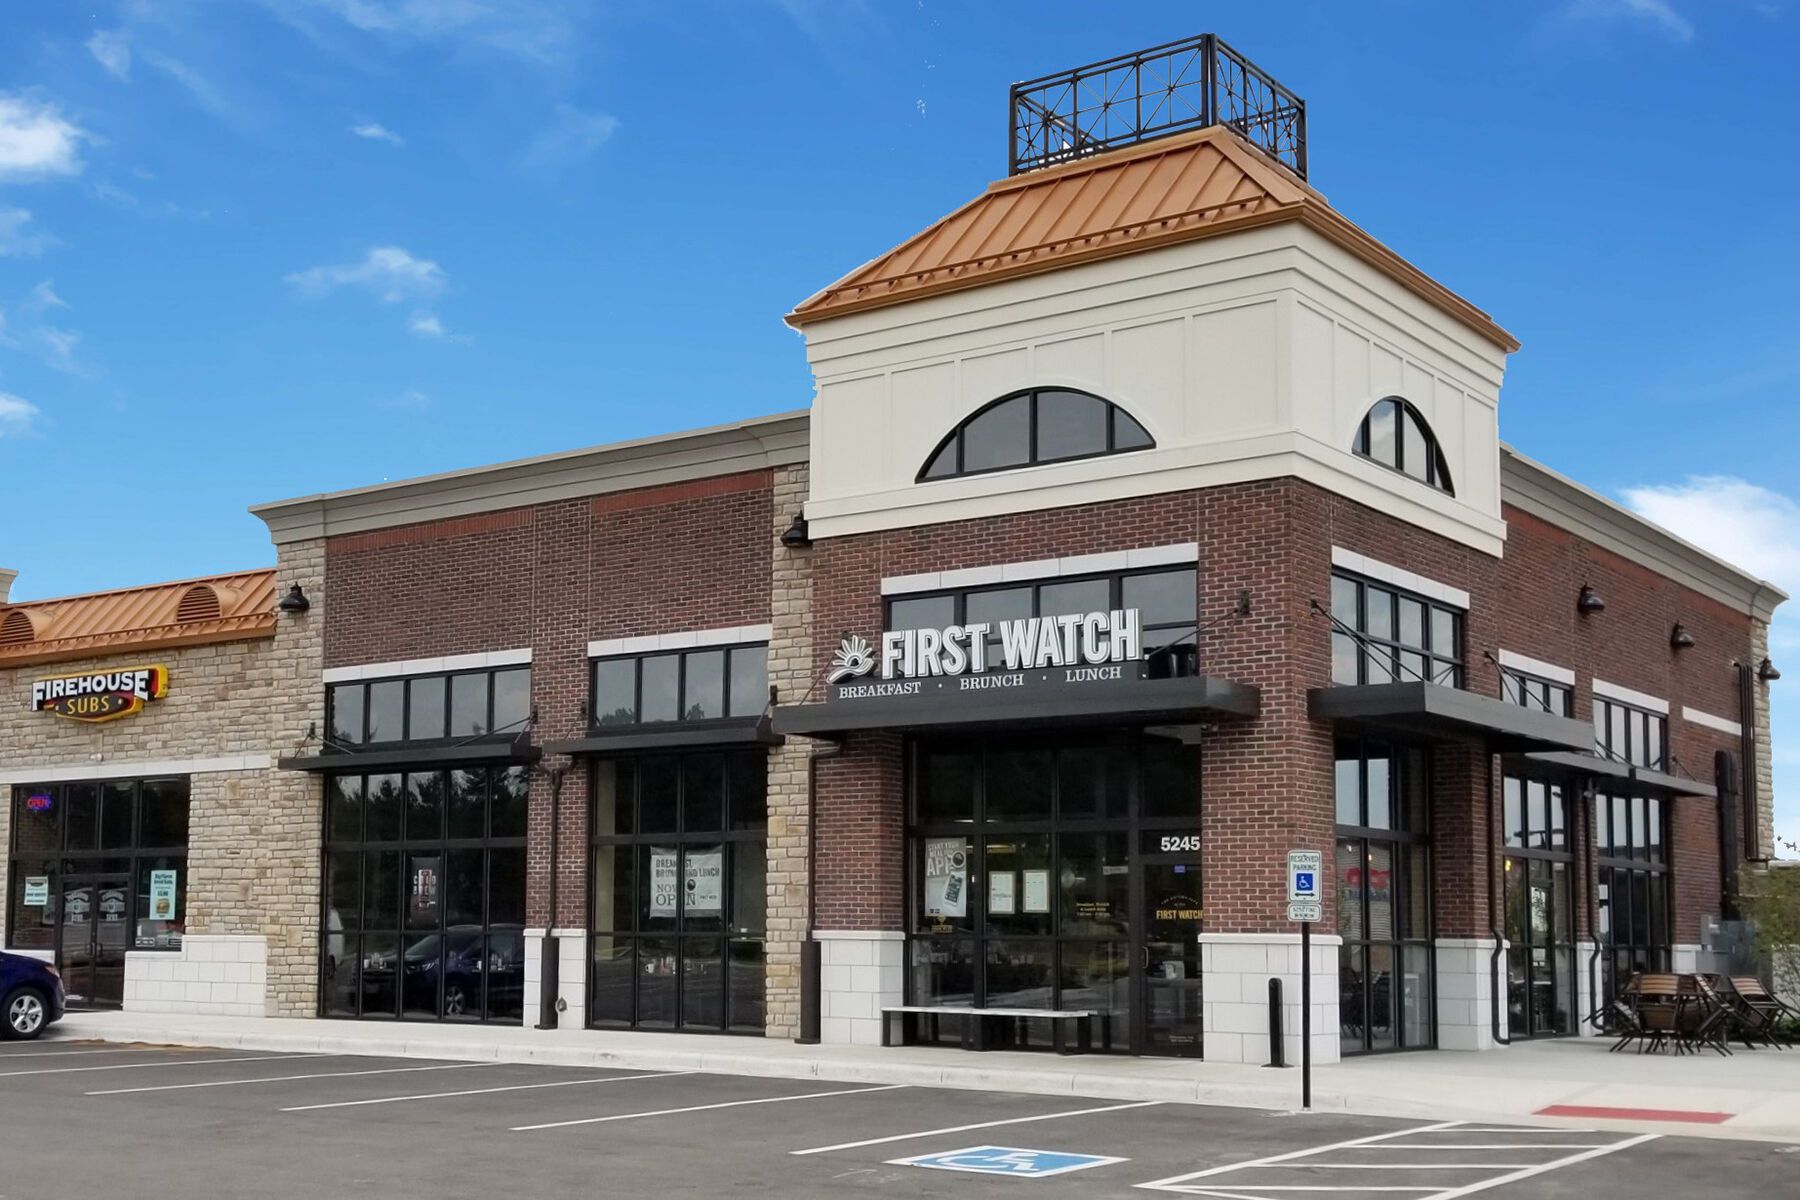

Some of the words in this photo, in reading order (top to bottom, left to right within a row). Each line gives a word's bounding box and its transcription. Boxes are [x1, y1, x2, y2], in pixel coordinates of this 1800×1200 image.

[882, 623, 990, 680] FIRST
[1000, 608, 1143, 670] WATCH
[32, 669, 149, 711] FIREHOUSE
[839, 681, 921, 699] BREAKFAST
[960, 673, 1024, 690] BRUNCH
[1065, 666, 1122, 682] LUNCH
[67, 695, 110, 715] SUBS
[1160, 835, 1200, 852] 5245
[656, 893, 696, 906] OPN
[1156, 910, 1177, 919] FIRST
